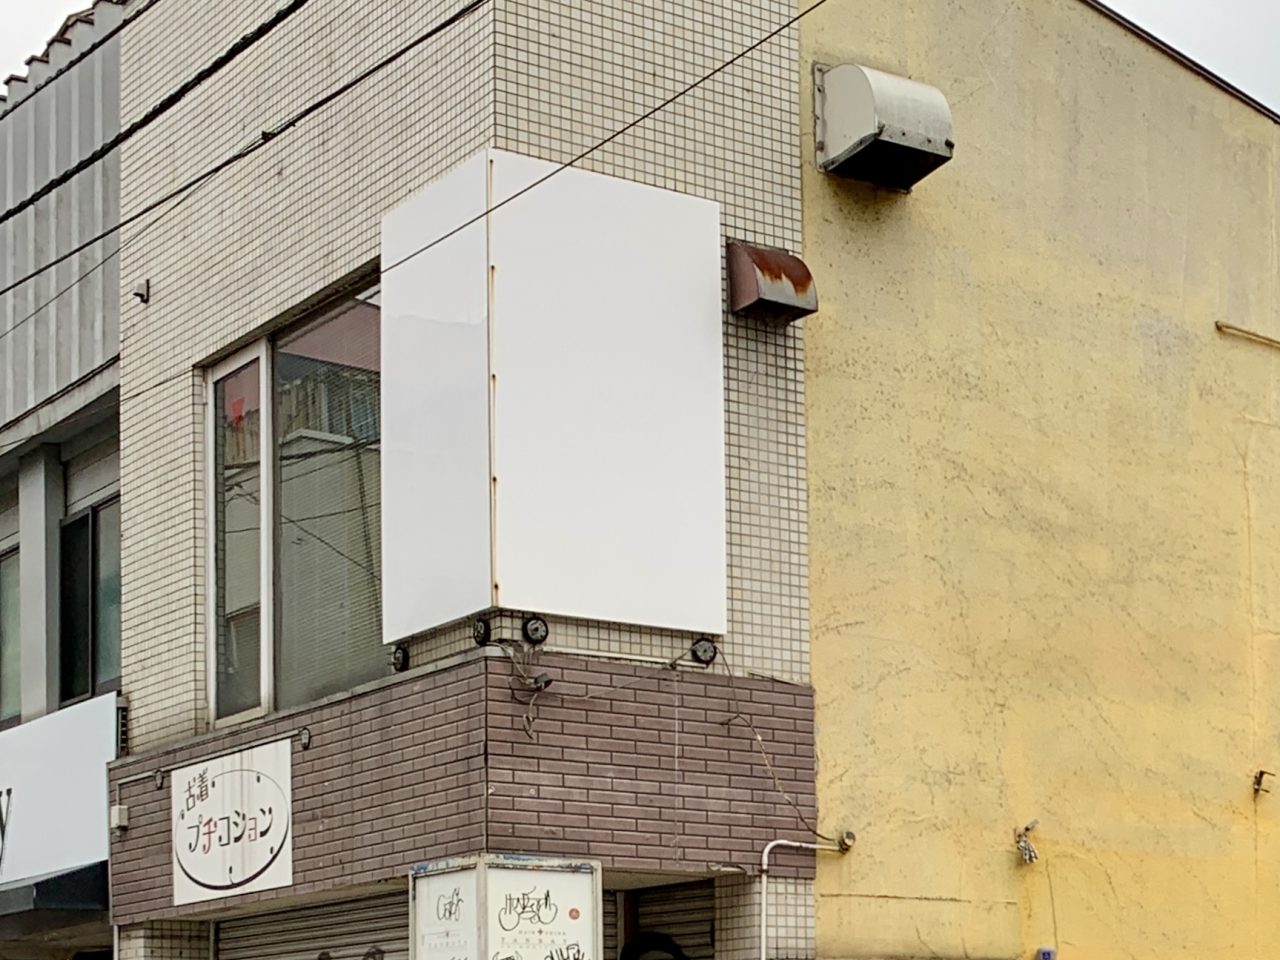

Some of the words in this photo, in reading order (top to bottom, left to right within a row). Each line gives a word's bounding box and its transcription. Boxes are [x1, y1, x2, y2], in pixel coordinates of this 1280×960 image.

[184, 767, 209, 811] 古着
[187, 806, 273, 854] プチコション
